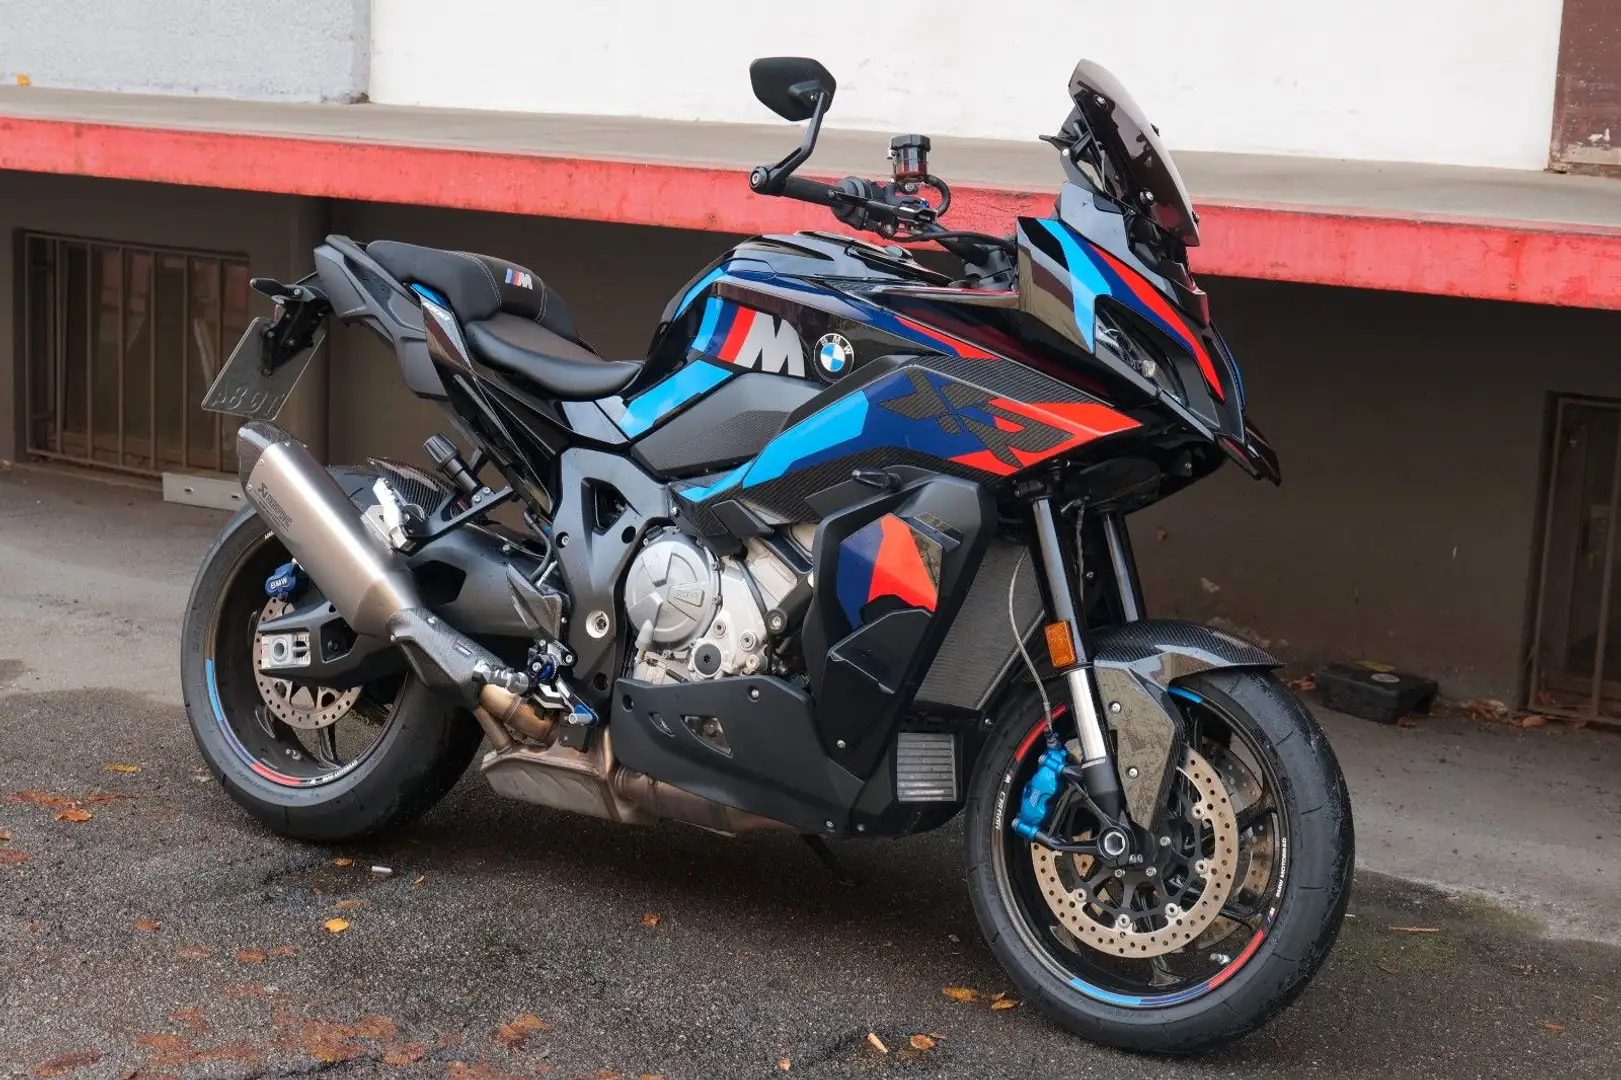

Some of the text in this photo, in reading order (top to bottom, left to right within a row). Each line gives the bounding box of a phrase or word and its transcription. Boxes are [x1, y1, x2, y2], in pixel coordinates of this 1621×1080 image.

[270, 576, 288, 590] BMW
[1275, 879, 1284, 898] BMW
[1280, 836, 1288, 879] MOTORRAD
